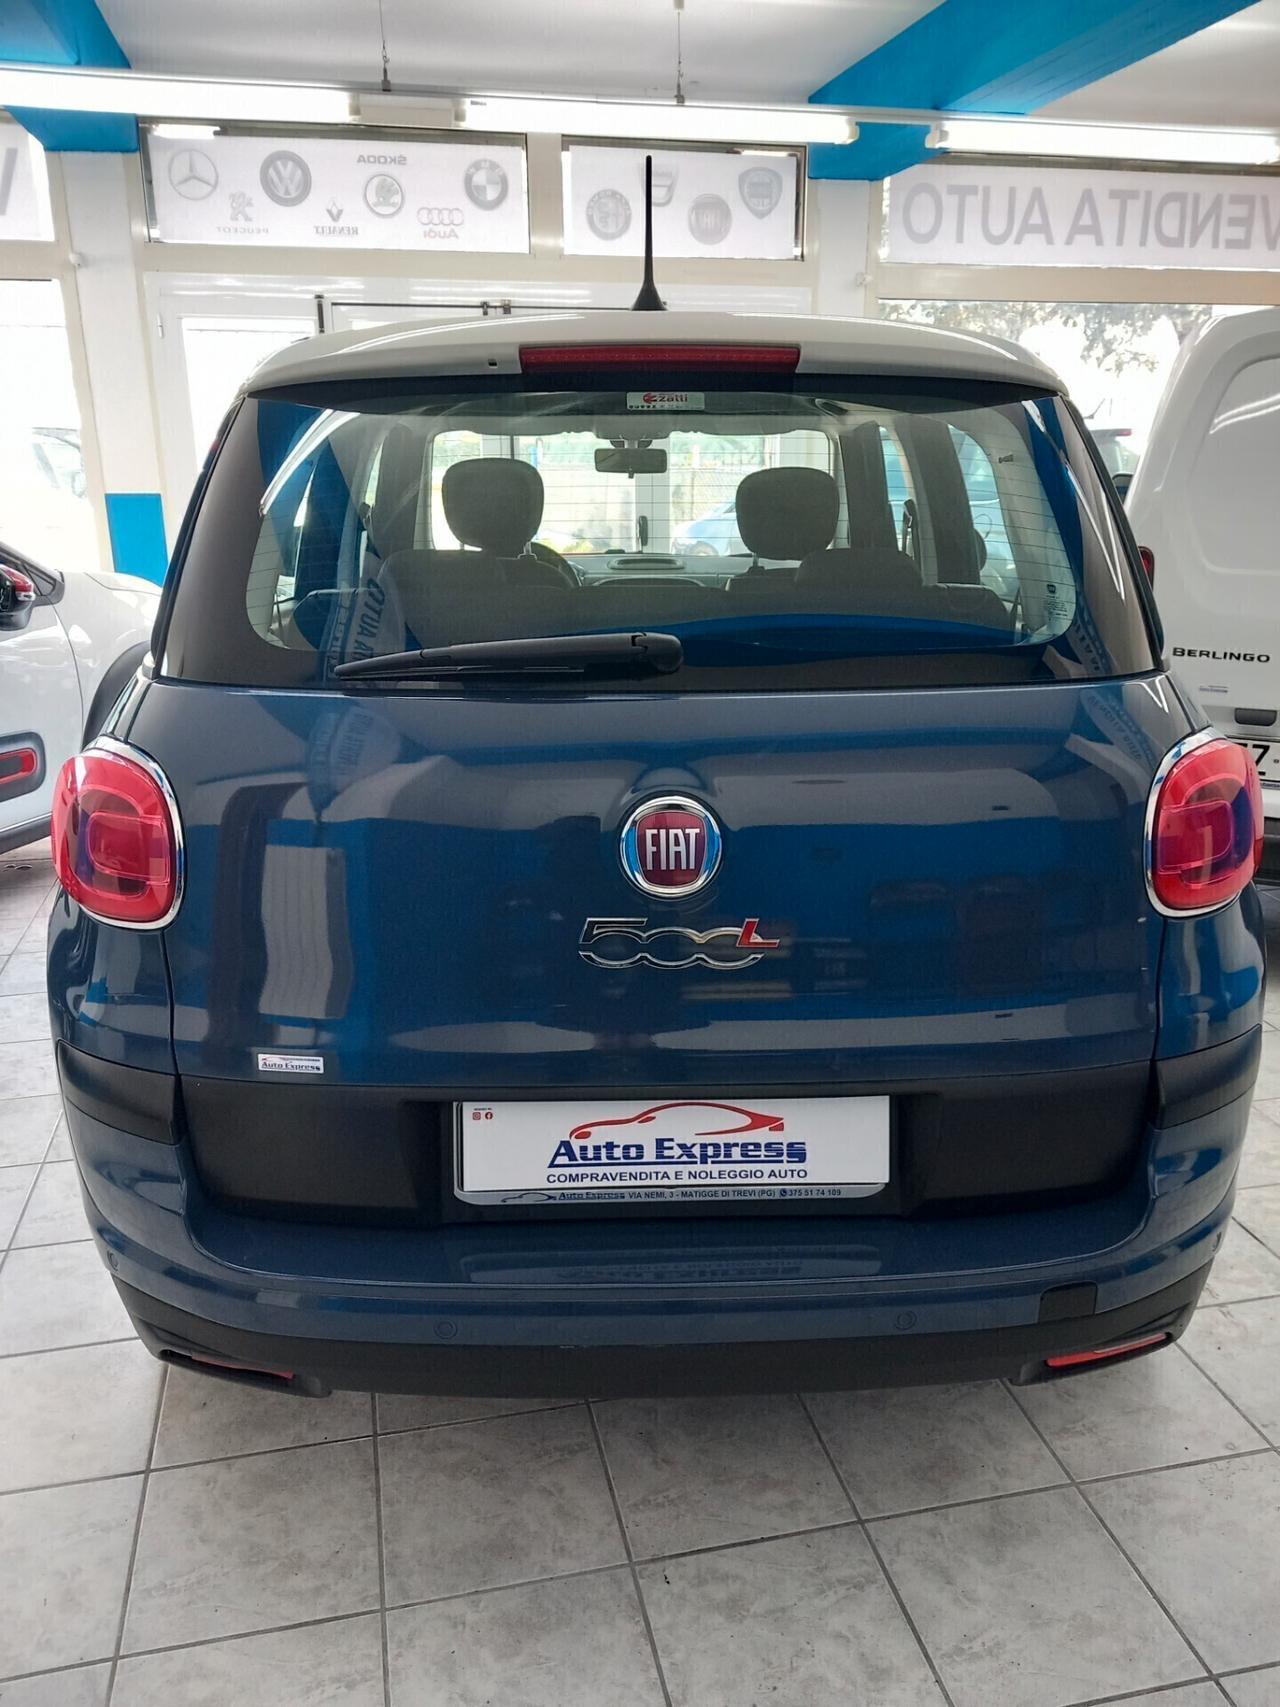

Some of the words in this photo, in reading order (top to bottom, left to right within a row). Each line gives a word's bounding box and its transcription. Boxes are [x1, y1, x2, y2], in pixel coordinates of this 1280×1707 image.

[1172, 647, 1271, 663] BERLINGO
[645, 828, 700, 870] FIAT
[578, 917, 780, 969] 500L
[261, 1061, 283, 1069] Auto
[285, 1062, 321, 1071] Express
[548, 1139, 644, 1166] Auto
[655, 1137, 807, 1165] Express
[547, 1170, 671, 1184] COMPRAVENDITA
[675, 1170, 684, 1181] E
[688, 1169, 763, 1180] NOLEGGIO
[768, 1168, 808, 1179] AUTO
[628, 1191, 643, 1199] VIA
[681, 1190, 720, 1199] MATIGGE
[722, 1189, 730, 1197] DI
[732, 1189, 756, 1197] TREVI
[758, 1189, 776, 1198] (PG)
